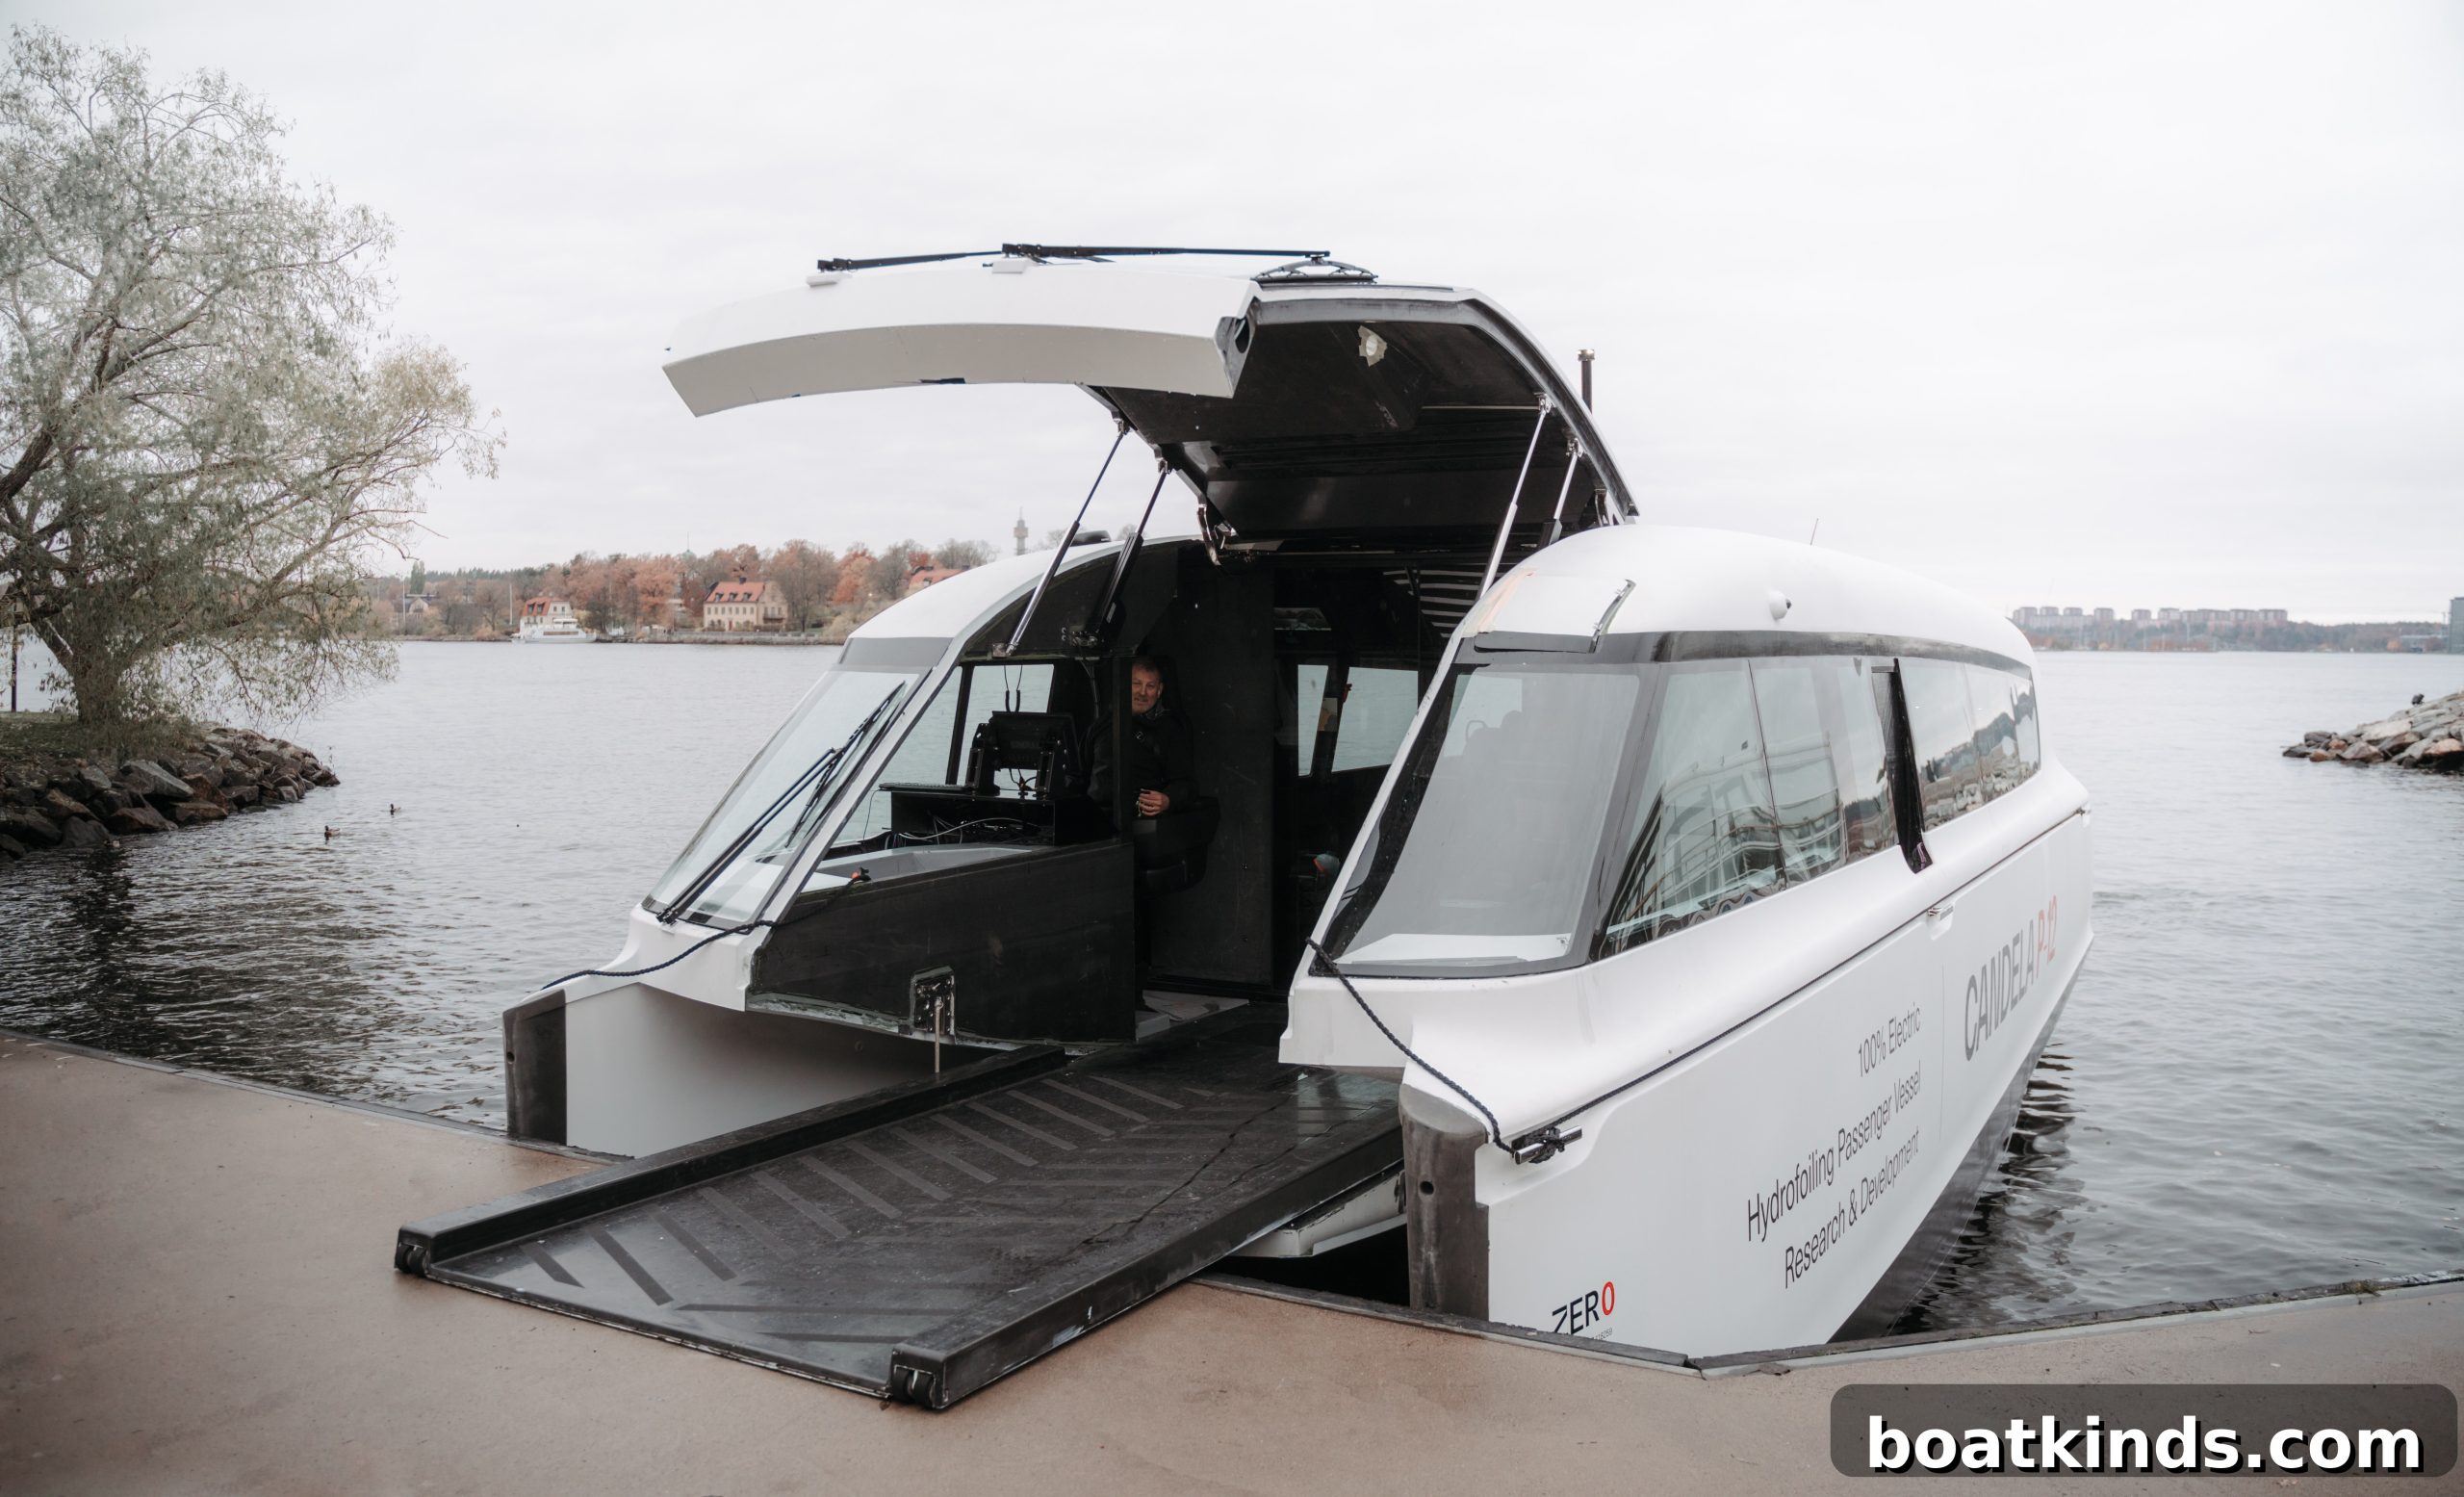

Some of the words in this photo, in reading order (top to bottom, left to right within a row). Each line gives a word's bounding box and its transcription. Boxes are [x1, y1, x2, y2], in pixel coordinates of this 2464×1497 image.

[1858, 1028, 1886, 1077] 100%
[1888, 1001, 1921, 1054] Electric
[1965, 919, 2035, 1061] CANDELA
[2036, 895, 2058, 978] P-12
[1748, 1148, 1835, 1243] Hydrofoiling
[1837, 1096, 1892, 1167] Passenger
[1893, 1060, 1921, 1115] Vessel
[1784, 1201, 1846, 1289] Research
[1849, 1188, 1858, 1227] &
[1861, 1129, 1919, 1215] Development
